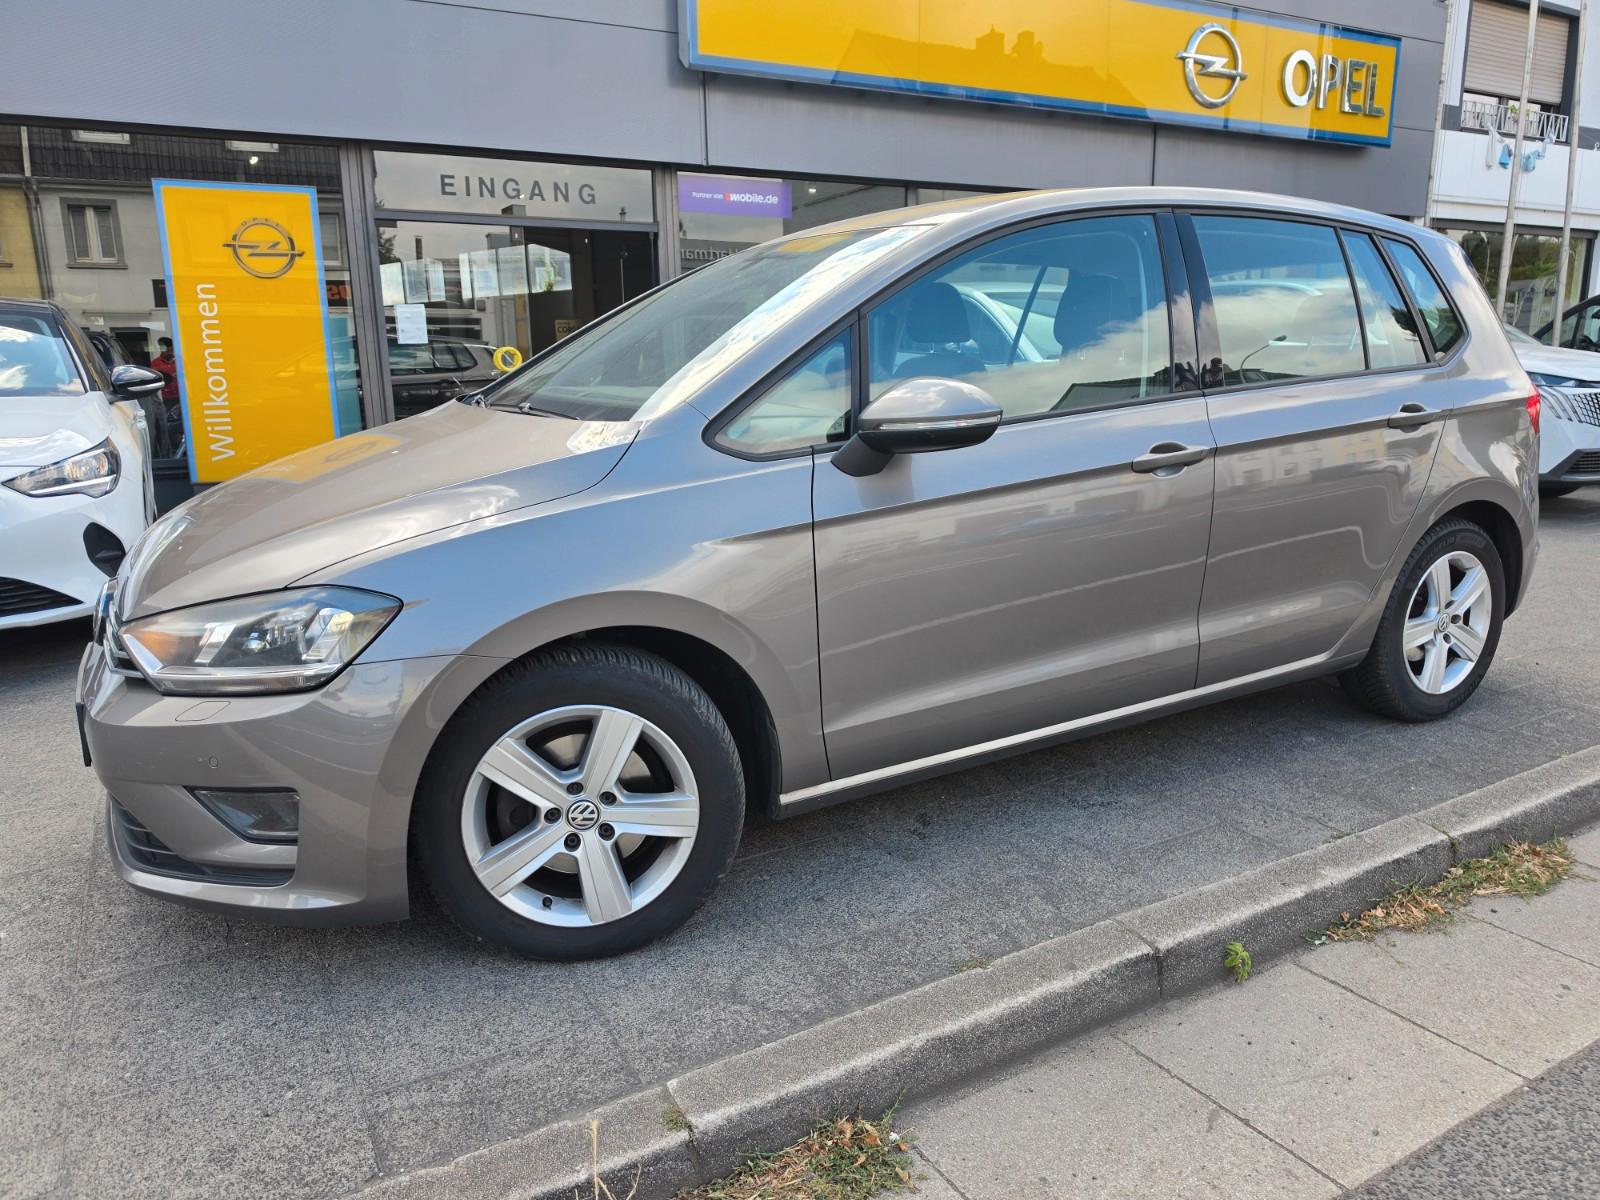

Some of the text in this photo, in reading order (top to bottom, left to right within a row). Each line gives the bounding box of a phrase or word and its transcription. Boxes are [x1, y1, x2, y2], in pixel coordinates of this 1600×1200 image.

[1281, 49, 1385, 117] OPEL
[440, 174, 596, 205] EINGANG
[727, 192, 779, 205] mobile.de
[196, 283, 236, 462] Willkommen
